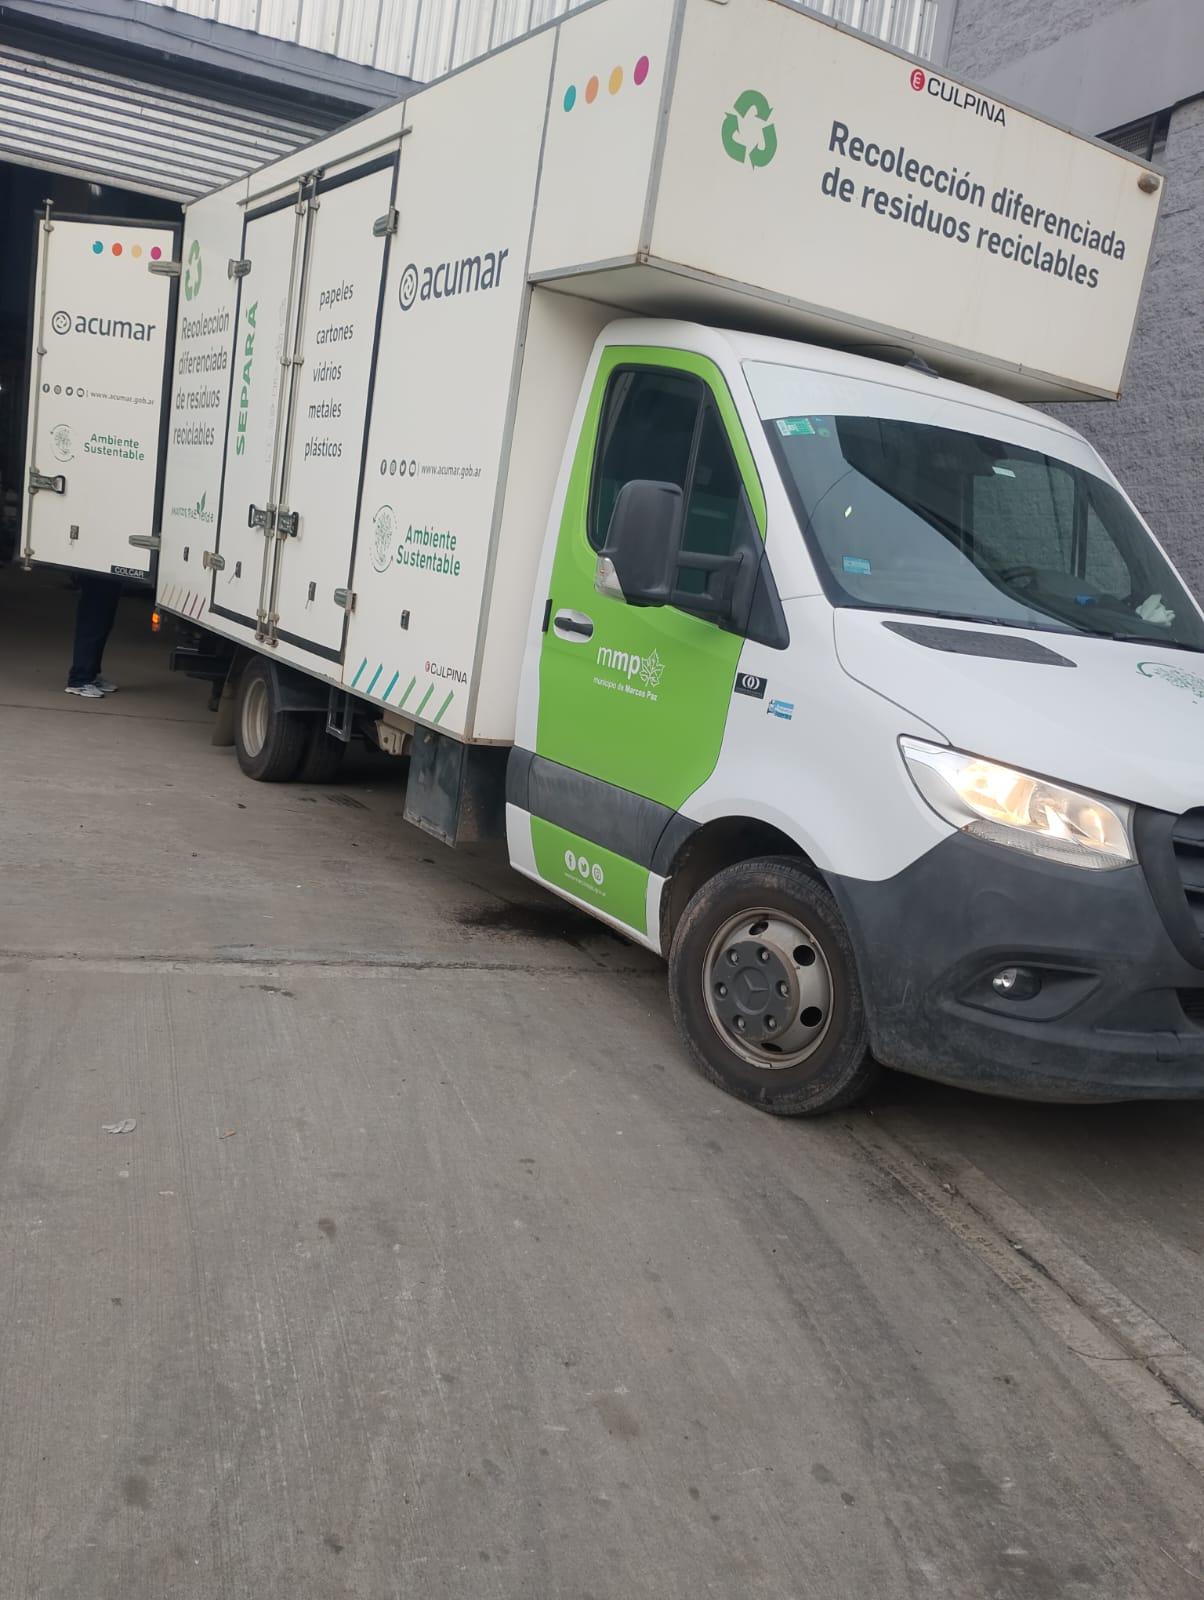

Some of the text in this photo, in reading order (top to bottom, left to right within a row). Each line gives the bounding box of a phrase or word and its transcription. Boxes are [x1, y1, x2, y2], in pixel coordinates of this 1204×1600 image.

[927, 77, 1006, 127] CULPINA
[828, 120, 1126, 261] Recolección diferenciada
[821, 166, 1100, 289] de residuos reciclables
[420, 248, 509, 301] acumar
[319, 280, 354, 311] papeles
[74, 315, 156, 342] acumar
[181, 306, 230, 341] Recolección
[316, 323, 354, 345] cartones
[178, 346, 228, 375] diferenciada
[312, 362, 342, 382] vidrios
[236, 300, 258, 456] SEPARÁ
[175, 385, 221, 410] de residuos
[308, 397, 342, 418] metales
[90, 432, 140, 449] Ambiente
[173, 421, 215, 446] reciclables
[83, 442, 145, 461] Sustentable
[304, 437, 343, 460] plásticos
[421, 464, 482, 479] www.acumar.gob.ar
[405, 525, 457, 551] Ambiente
[114, 566, 144, 578] COLCAR
[396, 545, 461, 576] Sustentable
[430, 662, 468, 685] CULPINA
[596, 646, 641, 680] mmp
